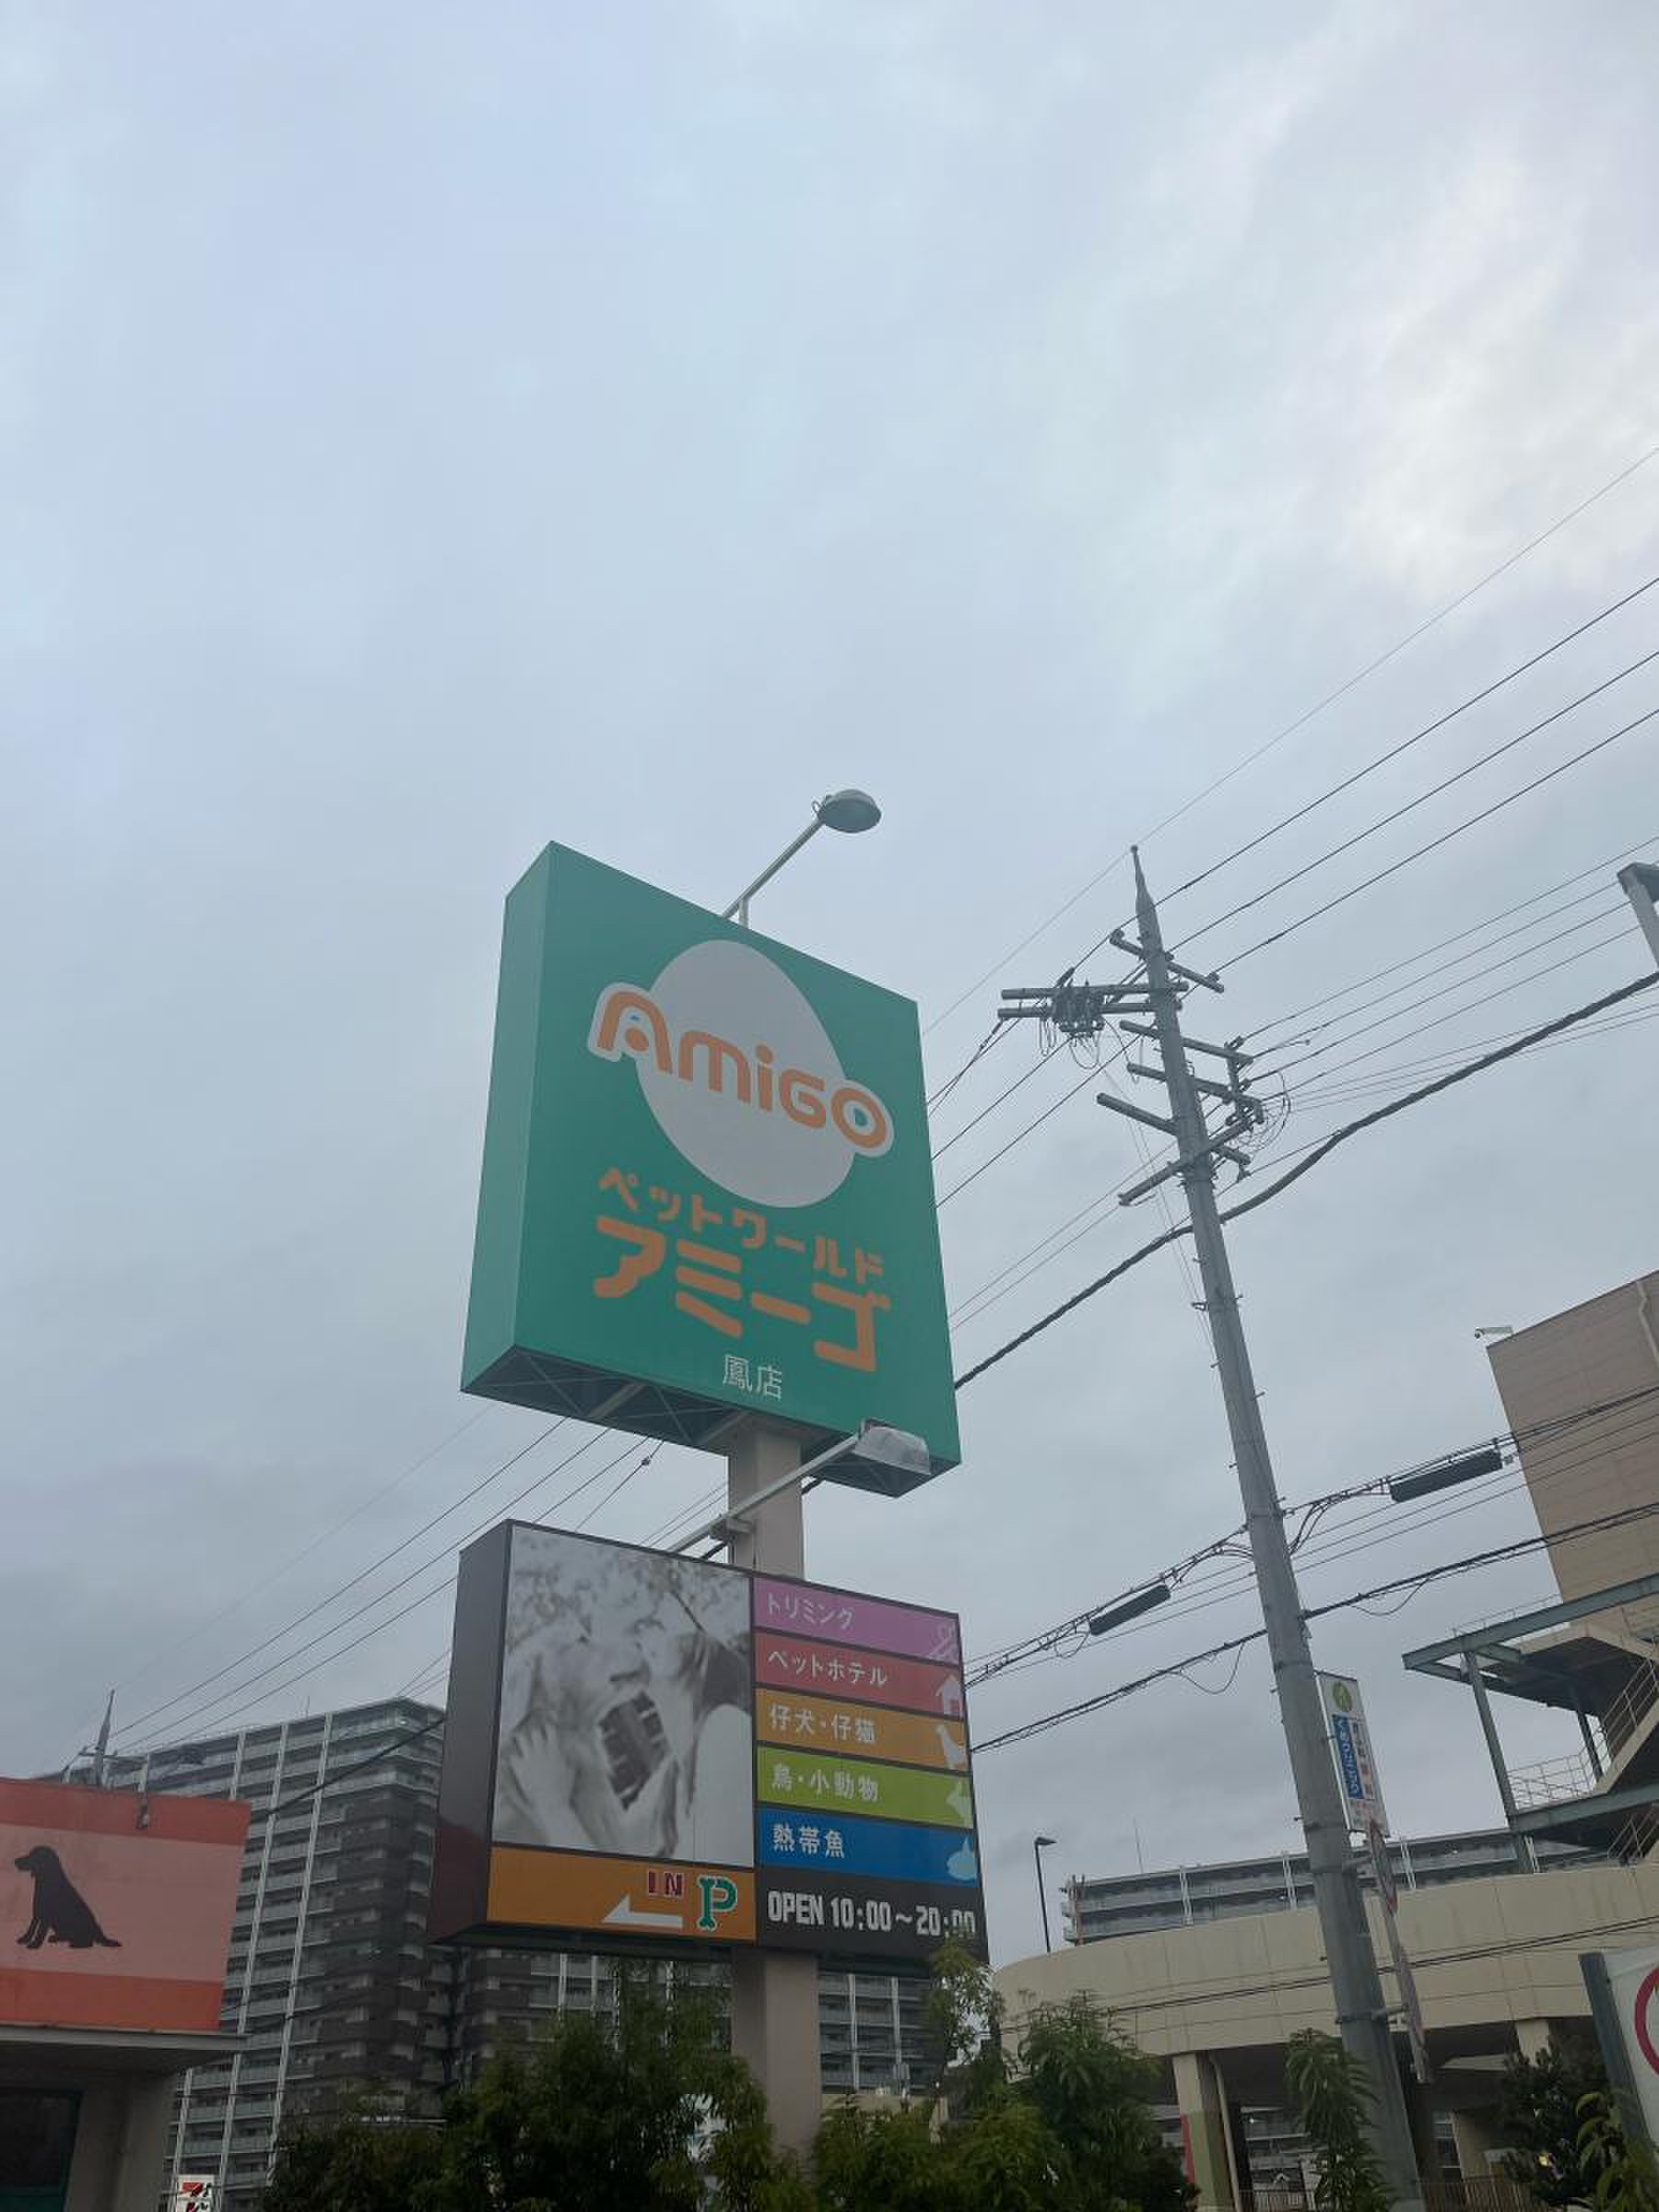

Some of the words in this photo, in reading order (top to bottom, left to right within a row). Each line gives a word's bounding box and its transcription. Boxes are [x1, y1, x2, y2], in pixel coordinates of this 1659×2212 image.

[598, 1167, 884, 1284] ペットワールド
[593, 1215, 892, 1373] アミーゴ
[721, 1353, 783, 1401] 鳳店
[767, 1592, 855, 1630] トリミング
[767, 1650, 888, 1686] ペットホテル
[769, 1702, 877, 1745] 仔犬・仔猫
[771, 1761, 879, 1801] 鳥・小動物
[772, 1822, 846, 1859] 熱帯魚
[648, 1870, 685, 1898] IN
[697, 1874, 738, 1932] P
[767, 1889, 826, 1926] OPEN
